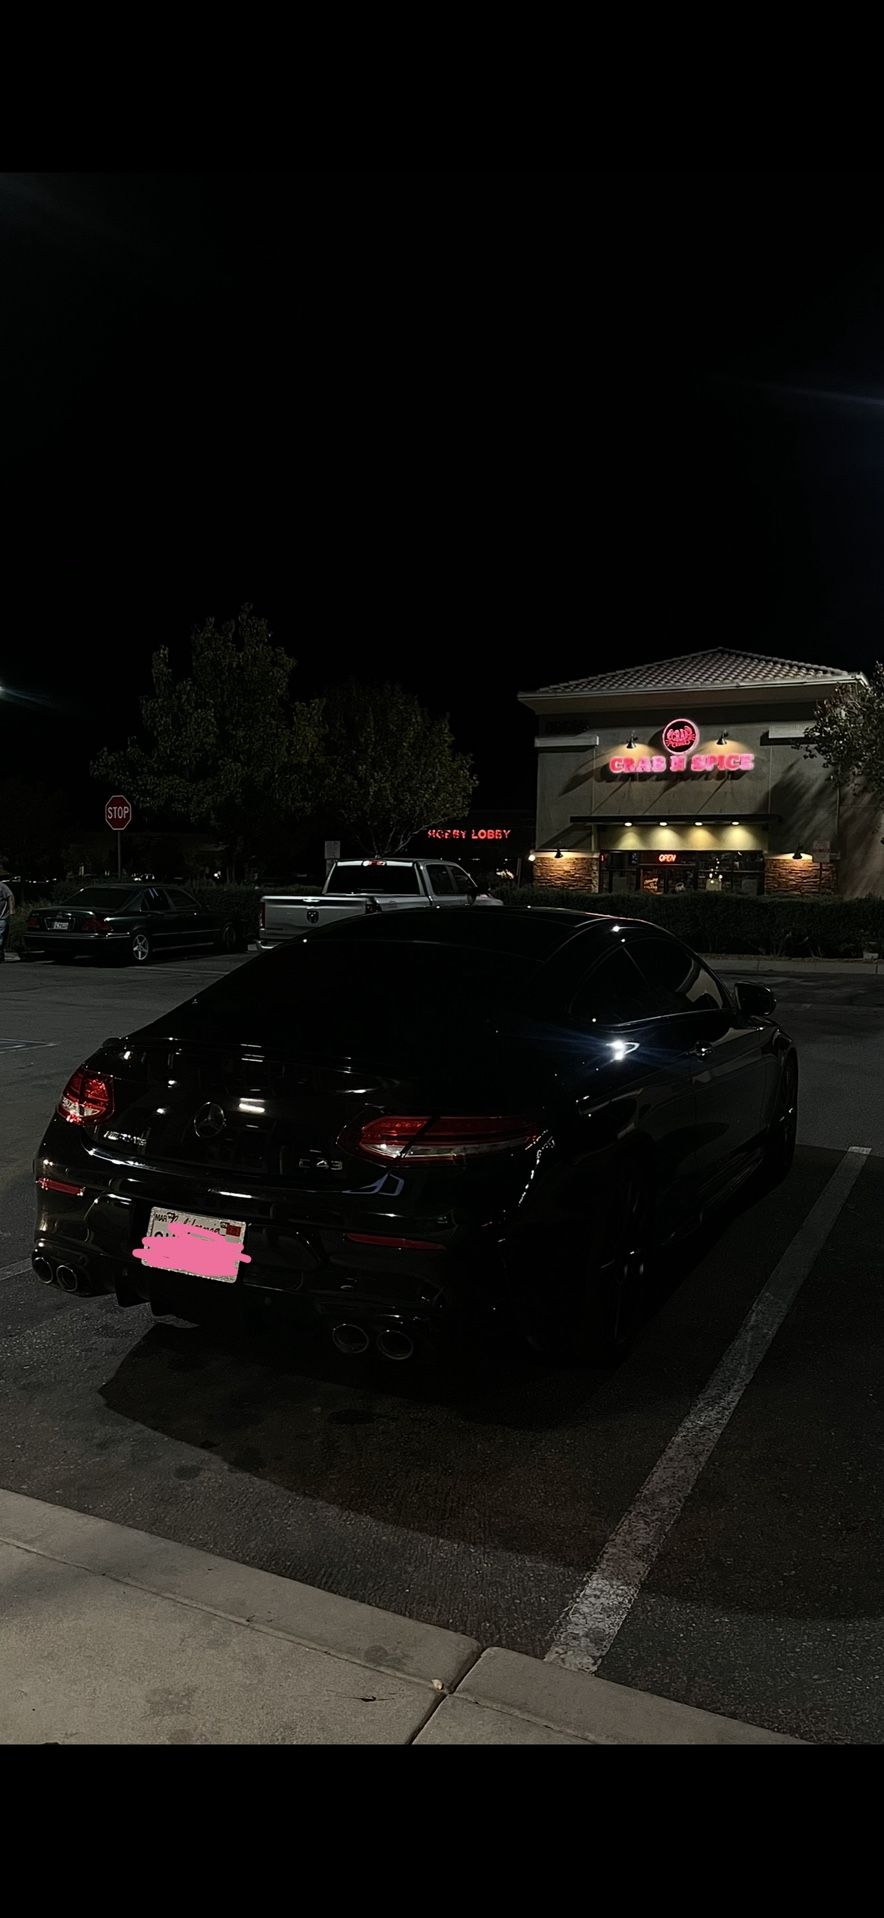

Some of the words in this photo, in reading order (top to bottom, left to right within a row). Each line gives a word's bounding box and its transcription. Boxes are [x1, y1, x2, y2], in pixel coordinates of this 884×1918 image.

[609, 756, 666, 773] CRAB
[670, 755, 686, 771] N
[691, 753, 755, 771] SPICE
[107, 806, 129, 819] STOP
[471, 829, 511, 839] LOBBY
[658, 854, 677, 862] OPEN
[154, 1213, 168, 1223] MAR
